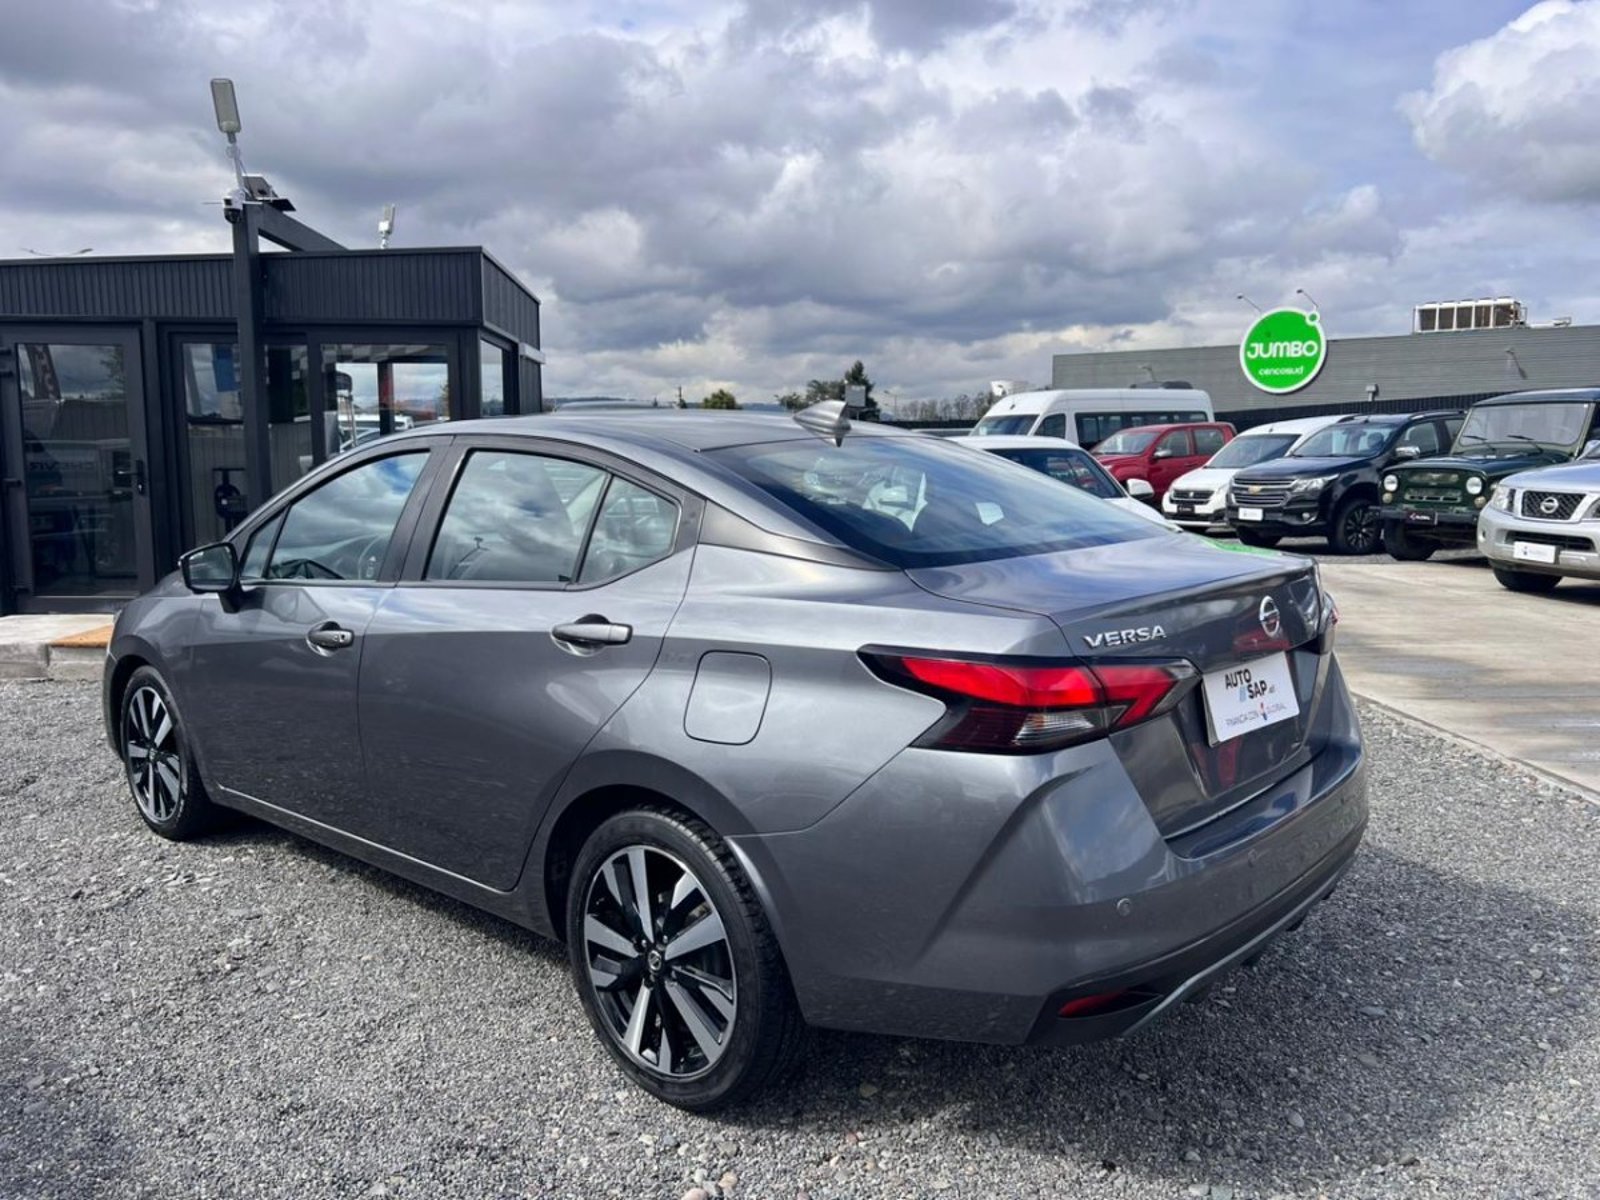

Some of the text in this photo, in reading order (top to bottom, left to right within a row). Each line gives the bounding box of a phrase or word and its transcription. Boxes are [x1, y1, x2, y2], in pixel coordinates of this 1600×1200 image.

[1246, 340, 1319, 359] JUMBO
[1258, 365, 1304, 376] cencosud
[1083, 625, 1167, 648] VERSA
[1225, 668, 1251, 690] AUTO
[1247, 680, 1267, 699] SAP
